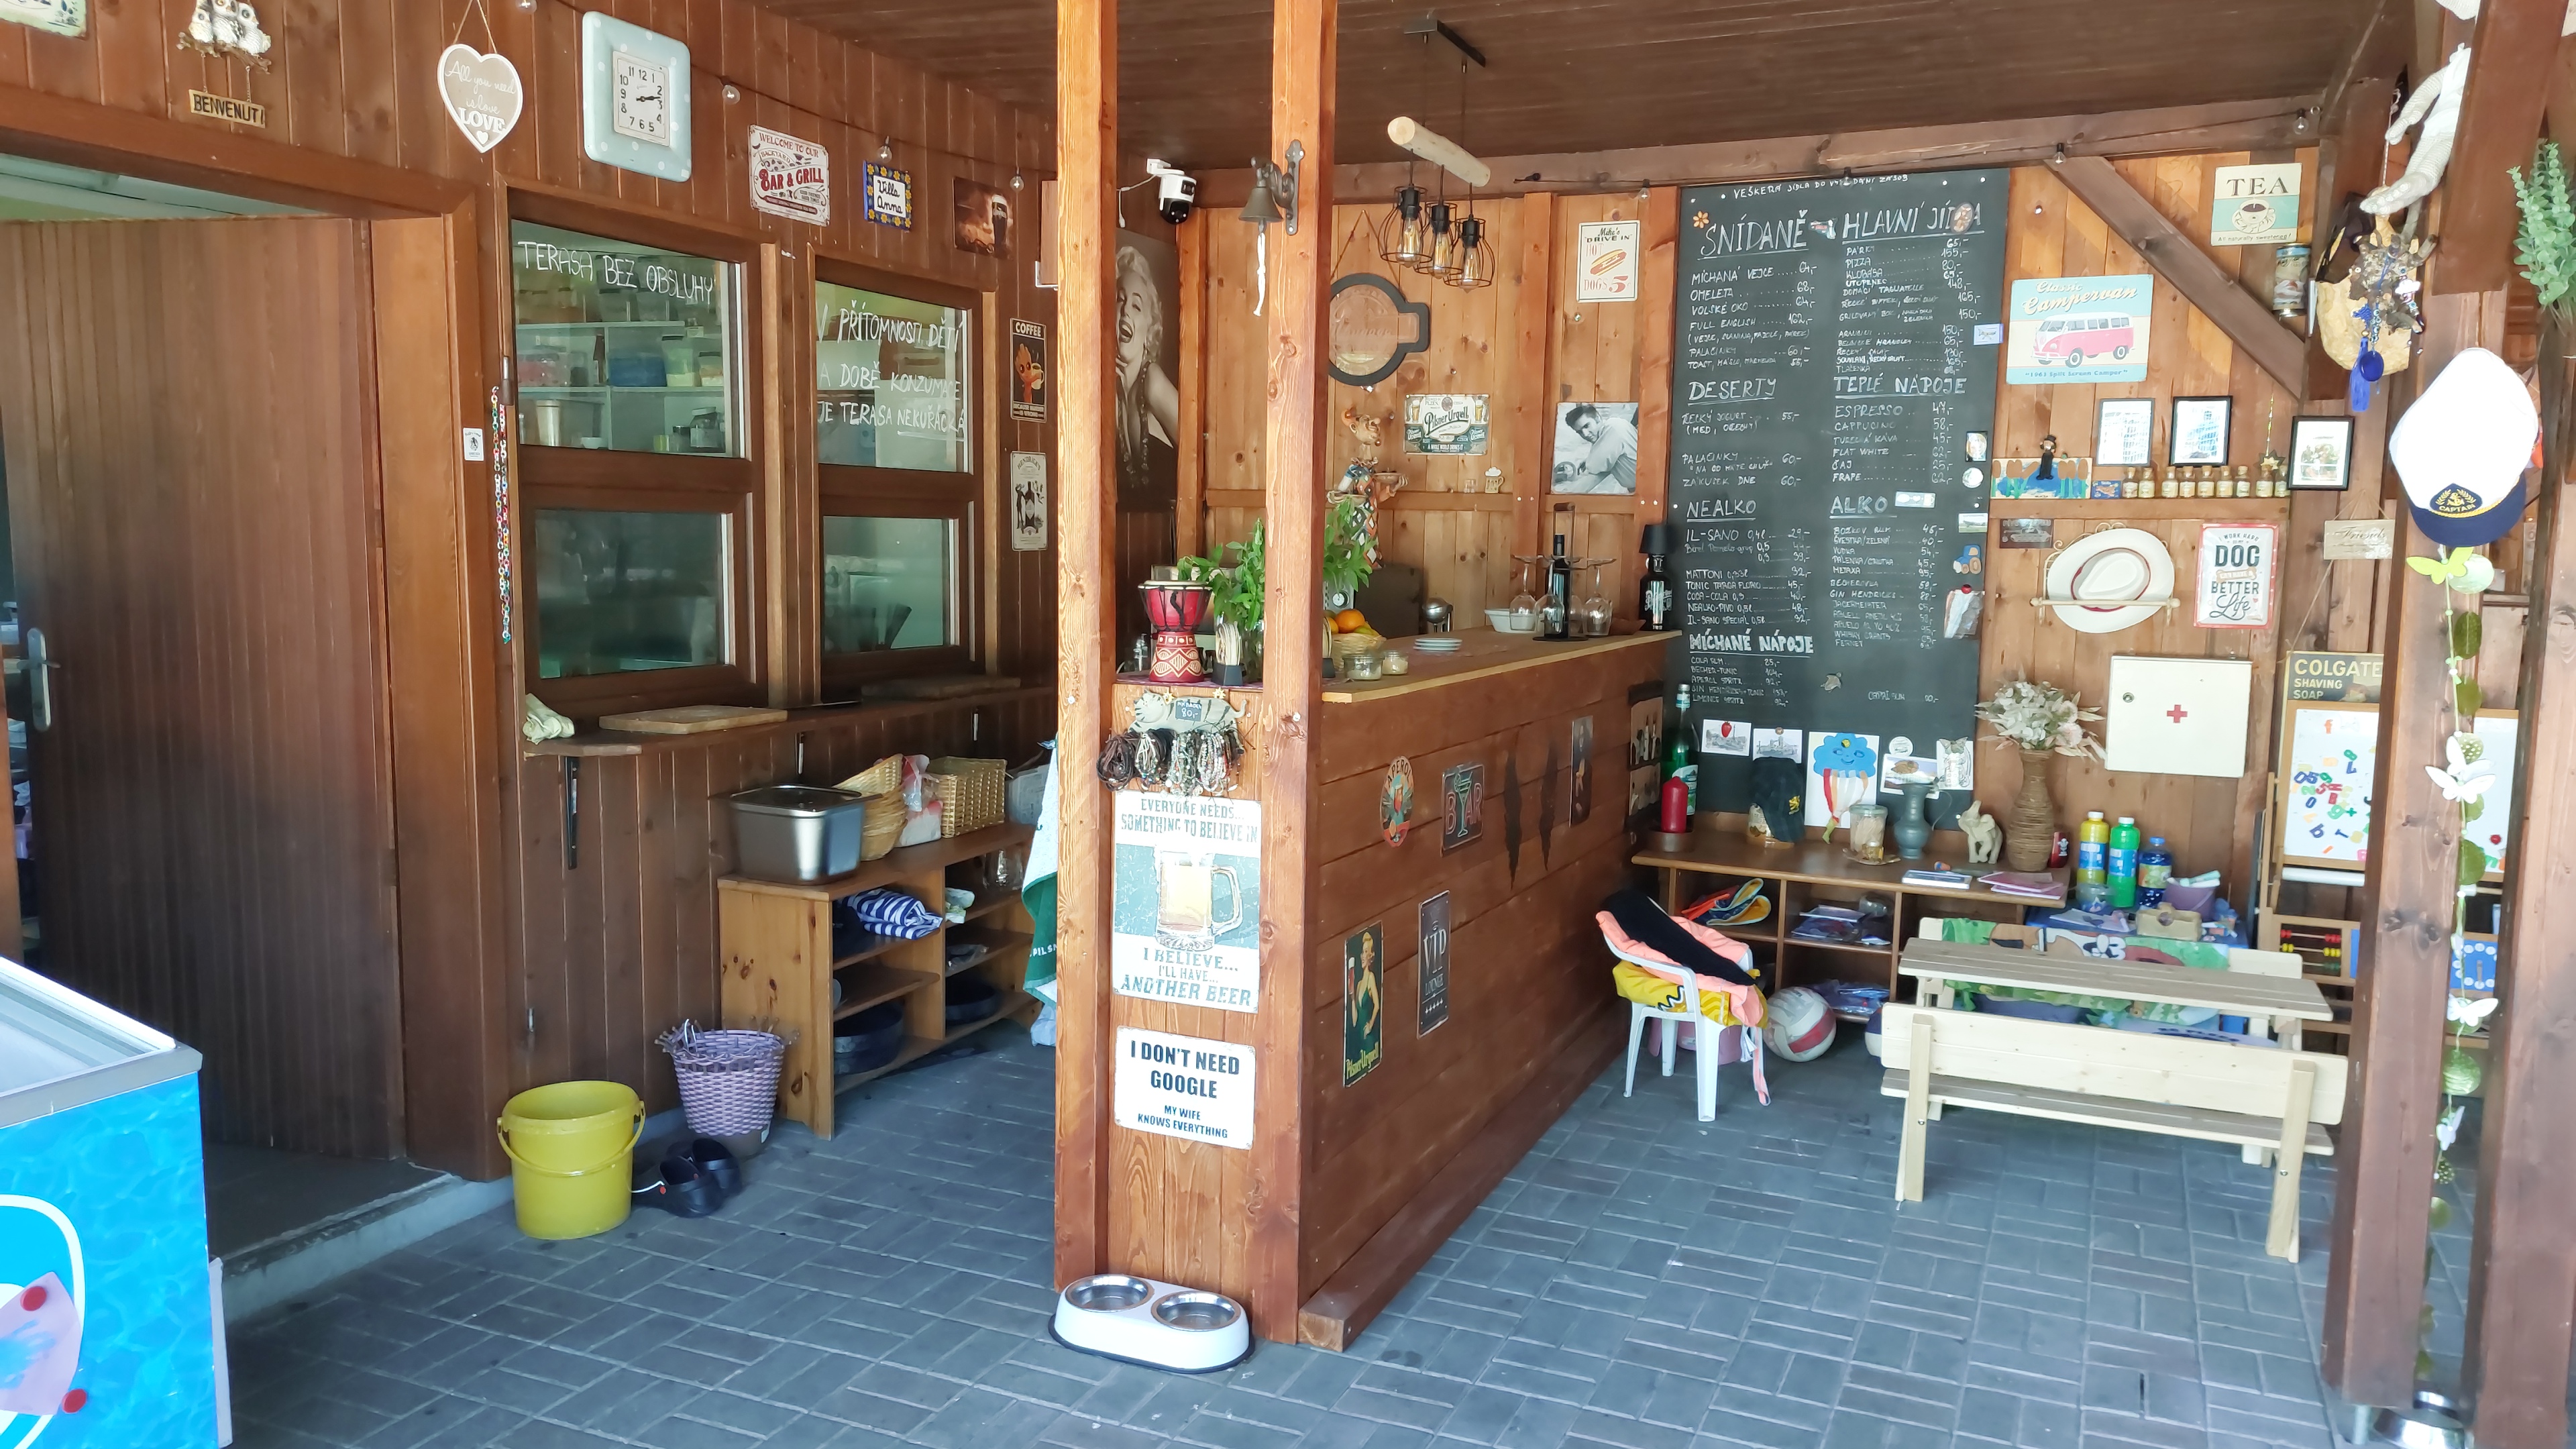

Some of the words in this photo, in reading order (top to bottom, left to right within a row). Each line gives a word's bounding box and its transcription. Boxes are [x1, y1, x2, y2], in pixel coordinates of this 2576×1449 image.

[445, 60, 472, 83] All
[472, 75, 491, 94] you
[495, 77, 516, 95] need
[629, 66, 634, 77] 11
[639, 69, 647, 81] 12
[652, 73, 655, 83] 1
[620, 74, 629, 86] 10
[621, 89, 626, 99] 9
[657, 85, 662, 95] 2
[193, 93, 265, 125] BENVENUTI
[466, 97, 476, 109] is
[475, 95, 500, 115] love
[621, 103, 627, 113] 8
[657, 100, 662, 110] 3
[458, 107, 506, 134] LOVE
[630, 116, 635, 125] 7
[639, 119, 645, 129] 6
[657, 113, 661, 123] 4
[649, 122, 654, 131] 5
[759, 133, 793, 150] WELCOME
[795, 144, 803, 153] TO
[806, 147, 818, 158] OUR
[761, 150, 790, 163] BACKYARD
[759, 169, 784, 191] BAR
[787, 173, 794, 187] &
[796, 168, 824, 184] GRILL
[2226, 176, 2289, 196] TEA
[876, 178, 900, 197] Villa
[1733, 184, 1782, 199] VEŠKERÁ
[1786, 182, 1809, 192] JÍDLA
[876, 197, 903, 215] Anna
[1842, 202, 1924, 239] HLAVNÍ
[1598, 227, 1619, 236] Mike's
[1700, 209, 1809, 257] SNÍDANĚ
[1587, 244, 1604, 257] HOT
[1845, 258, 1871, 268] PIZZA
[518, 241, 593, 281] TERASA
[603, 255, 637, 288] BEZ
[646, 264, 713, 305] OBSLUHY
[1691, 266, 1741, 285] MÍCHANÁ
[1747, 268, 1774, 280] VEJCE
[1846, 268, 1883, 279] KLOBÁSA
[1585, 278, 1608, 290] DOGS
[1845, 279, 1888, 287] UTOPENEC
[2036, 281, 2083, 292] Classic
[1690, 288, 1733, 301] OMELETA
[2022, 286, 2137, 315] Campervan
[1692, 301, 1727, 315] VOLSKÉ
[1731, 303, 1748, 312] OKO
[817, 303, 828, 343] V
[837, 299, 923, 343] PŘÍTOMNOSTI
[928, 317, 965, 353] DĚTÍ
[1016, 322, 1041, 337] COFFEE
[1689, 321, 1715, 331] FULL
[1721, 317, 1756, 327] ENGLISH
[820, 362, 830, 386] A
[839, 361, 881, 389] DOBĚ
[891, 372, 961, 401] KONZUMACE
[1834, 372, 1884, 393] TEPLÉ
[1895, 374, 1967, 394] NÁPOJE
[1688, 378, 1777, 400] DESERTY
[817, 401, 833, 423] JE
[839, 402, 892, 426] TERASA
[898, 405, 965, 433] NEKUŘÁCKÁ
[1717, 413, 1747, 421] JOGURT
[1835, 405, 1903, 418] ESPRESSO
[1424, 412, 1448, 436] Pilsner
[1833, 449, 1856, 457] FLAT
[1832, 460, 1852, 470] ČAJ
[1737, 476, 1756, 486] DNE
[1833, 473, 1862, 482] FRAPE
[1686, 499, 1756, 518] NEALKO
[1830, 496, 1888, 515] ALKO
[2438, 502, 2476, 512] CAPTAIN
[1686, 529, 1739, 542] IL-SANO
[2243, 533, 2259, 541] HARD
[2215, 545, 2260, 567] DOG
[1686, 569, 1723, 580] MATTONI
[1833, 566, 1860, 574] METAXA
[1686, 582, 1710, 590] TONIC
[2211, 581, 2259, 594] BETTER
[1687, 592, 1728, 600] COCA-COLA
[1830, 590, 1845, 598] GIN
[1688, 603, 1734, 612] NEALKO-PIVO
[2210, 592, 2250, 621] Life
[1687, 615, 1720, 625] IL-SANO
[1723, 614, 1750, 625] SPECIAL
[1689, 628, 1752, 651] MÍCHANÉ
[1759, 629, 1815, 654] NÁPOJE
[1690, 656, 1708, 664] COLA
[2294, 659, 2383, 678] COLGATE
[2294, 678, 2343, 689] SHAVING
[2294, 690, 2324, 700] SOAP
[1387, 759, 1412, 788] APEROL
[1141, 798, 1196, 816] EVERYONE
[1446, 782, 1482, 835] BAR
[1121, 814, 1181, 833] SOMETHING
[1184, 820, 1196, 837] TO
[1200, 822, 1242, 842] BELIEVE
[1246, 825, 1257, 843] IN
[1143, 947, 1148, 961] I
[1423, 928, 1447, 977] VIP
[1159, 965, 1176, 978] I'LL
[1121, 974, 1200, 1001] ANOTHER
[1206, 986, 1251, 1006] BEER
[1131, 1040, 1136, 1058] I
[1141, 1042, 1189, 1068] DON'T
[1196, 1053, 1240, 1075] NEED
[1150, 1070, 1218, 1099] GOOGLE
[1164, 1105, 1177, 1116] MY
[1179, 1108, 1201, 1121] WIFE
[1138, 1113, 1171, 1129] KNOWS
[1173, 1120, 1228, 1139] EVERYTHING
